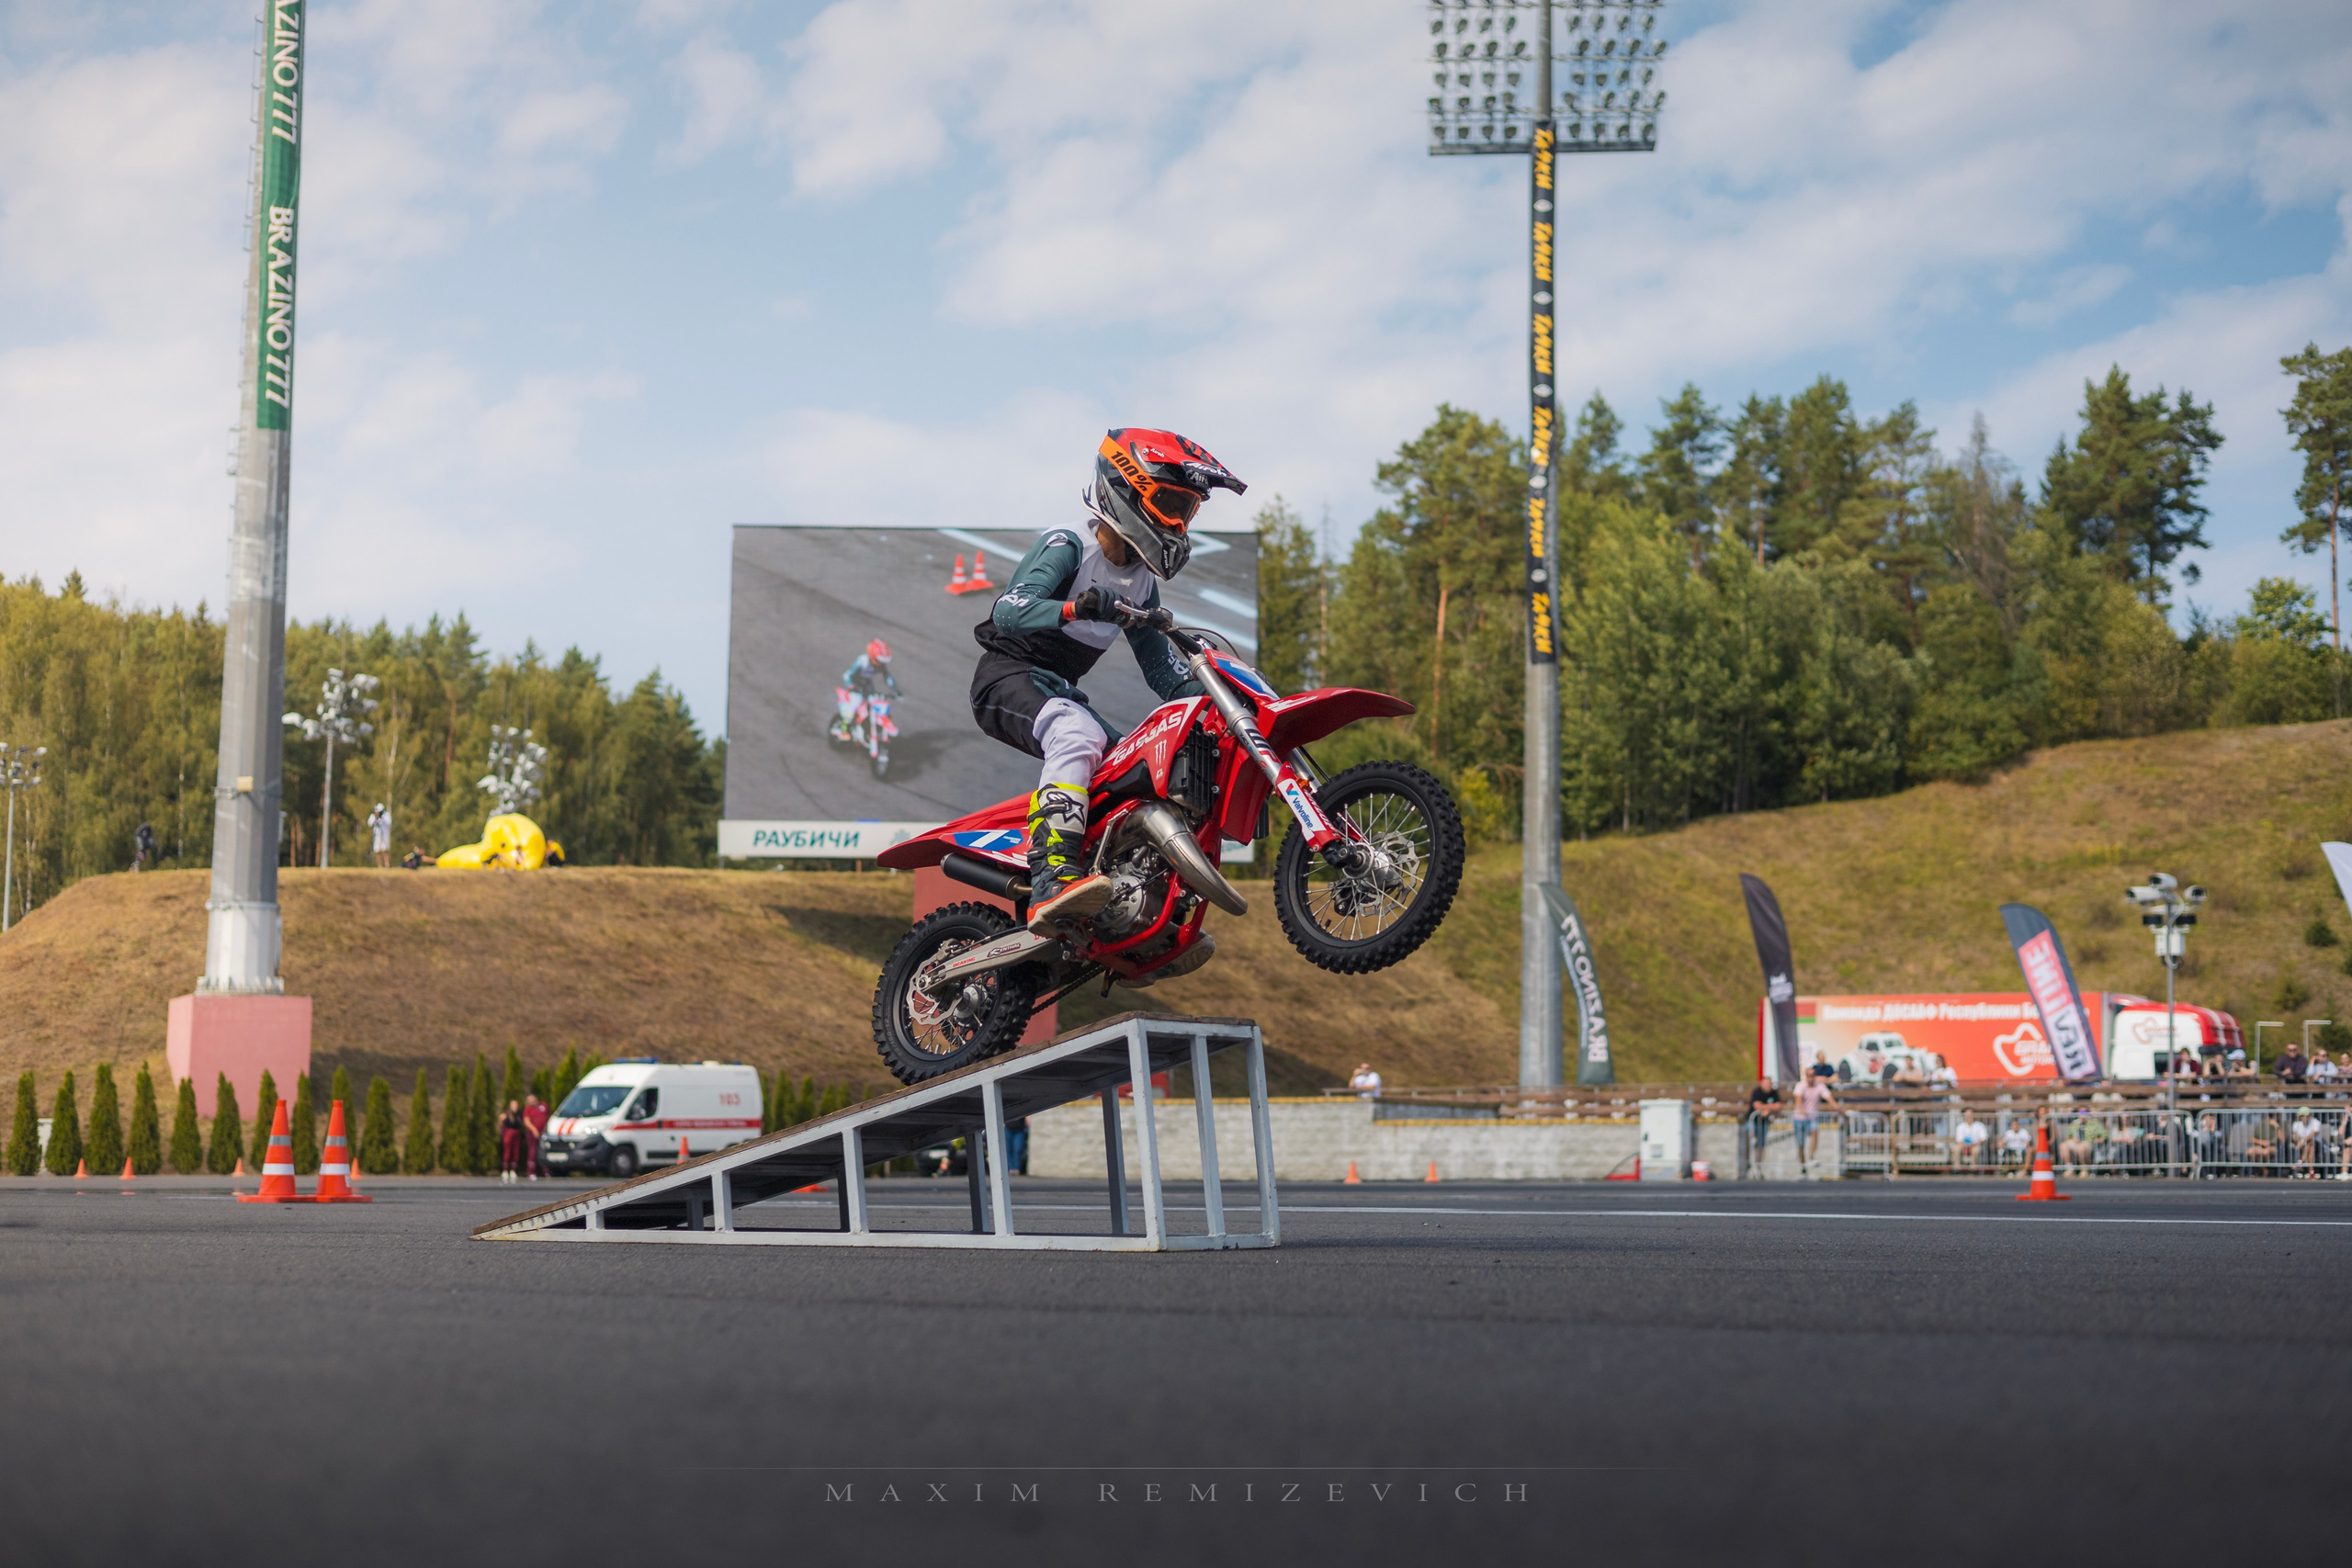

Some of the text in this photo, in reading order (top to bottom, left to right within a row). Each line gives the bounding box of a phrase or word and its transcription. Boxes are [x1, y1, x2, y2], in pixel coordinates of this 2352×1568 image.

[1110, 450, 1154, 492] 100%
[1292, 796, 1314, 829] Valvoline
[753, 829, 860, 848] РАУБИЧИ
